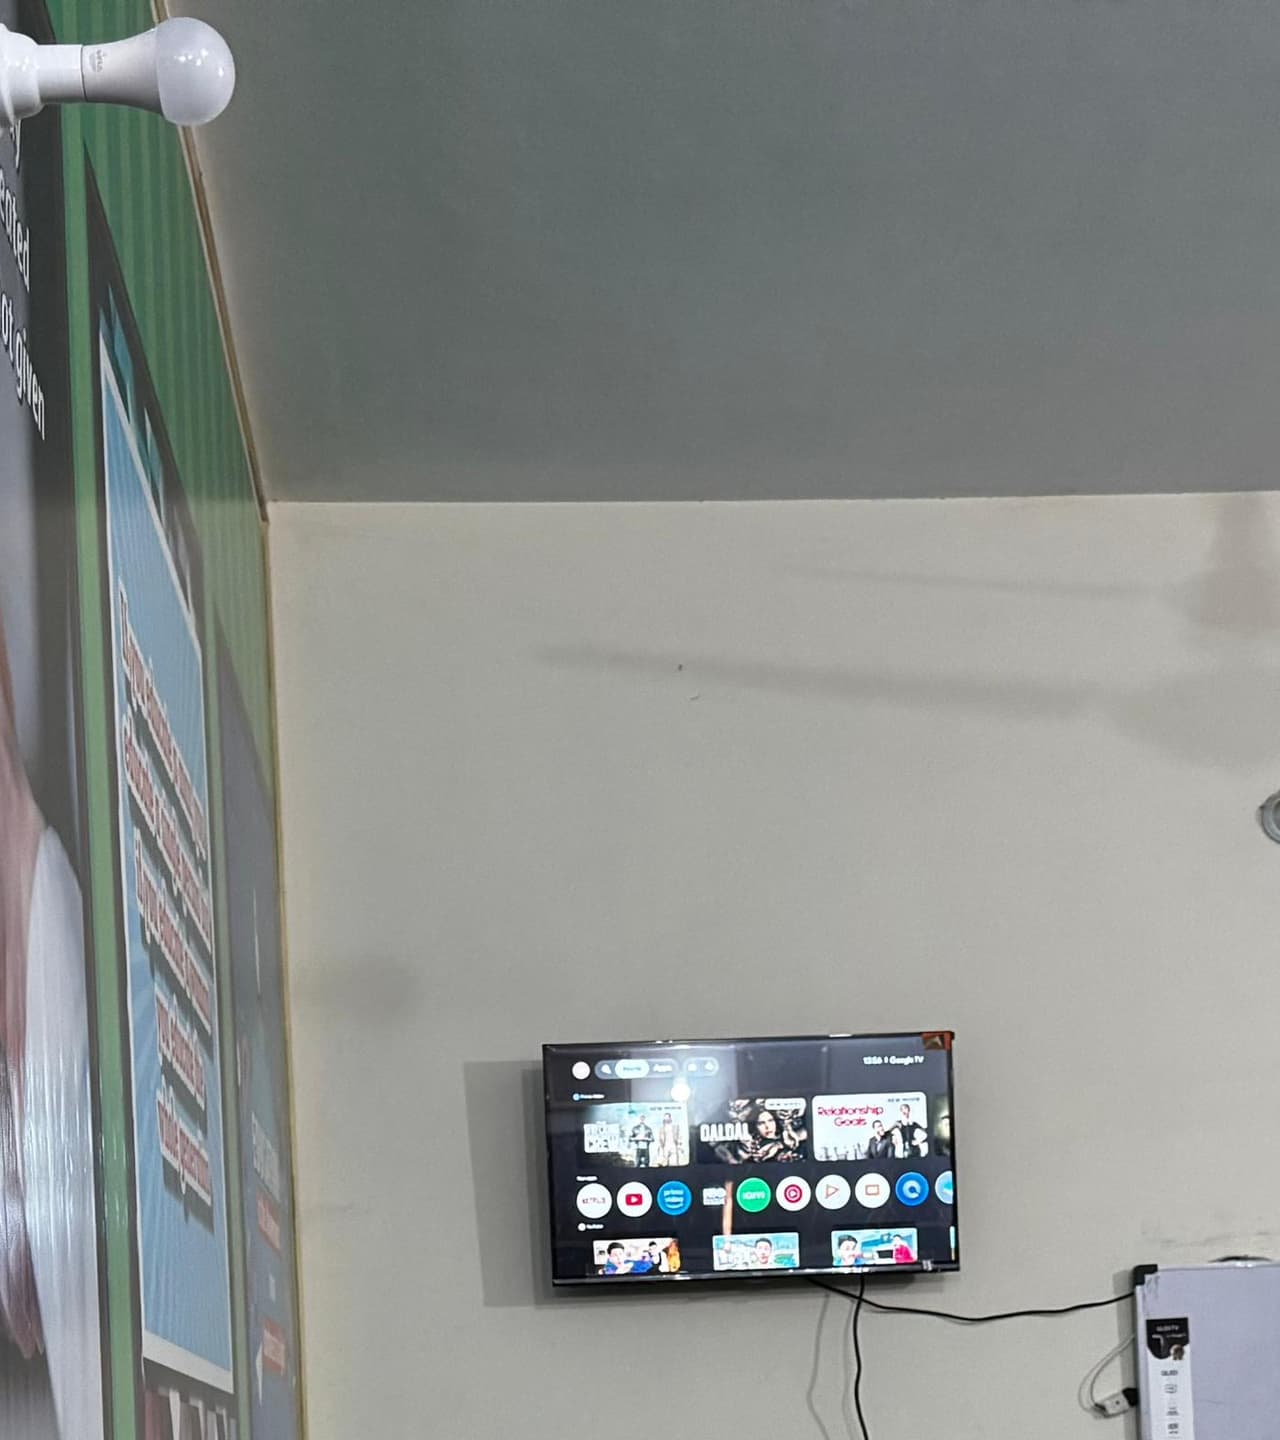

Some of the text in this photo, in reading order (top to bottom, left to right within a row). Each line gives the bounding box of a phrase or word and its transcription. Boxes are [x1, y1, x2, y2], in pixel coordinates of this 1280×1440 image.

[15, 327, 45, 441] given
[817, 1103, 884, 1117] Relationship
[833, 1117, 867, 1127] Goals
[700, 1122, 750, 1142] DALDAL
